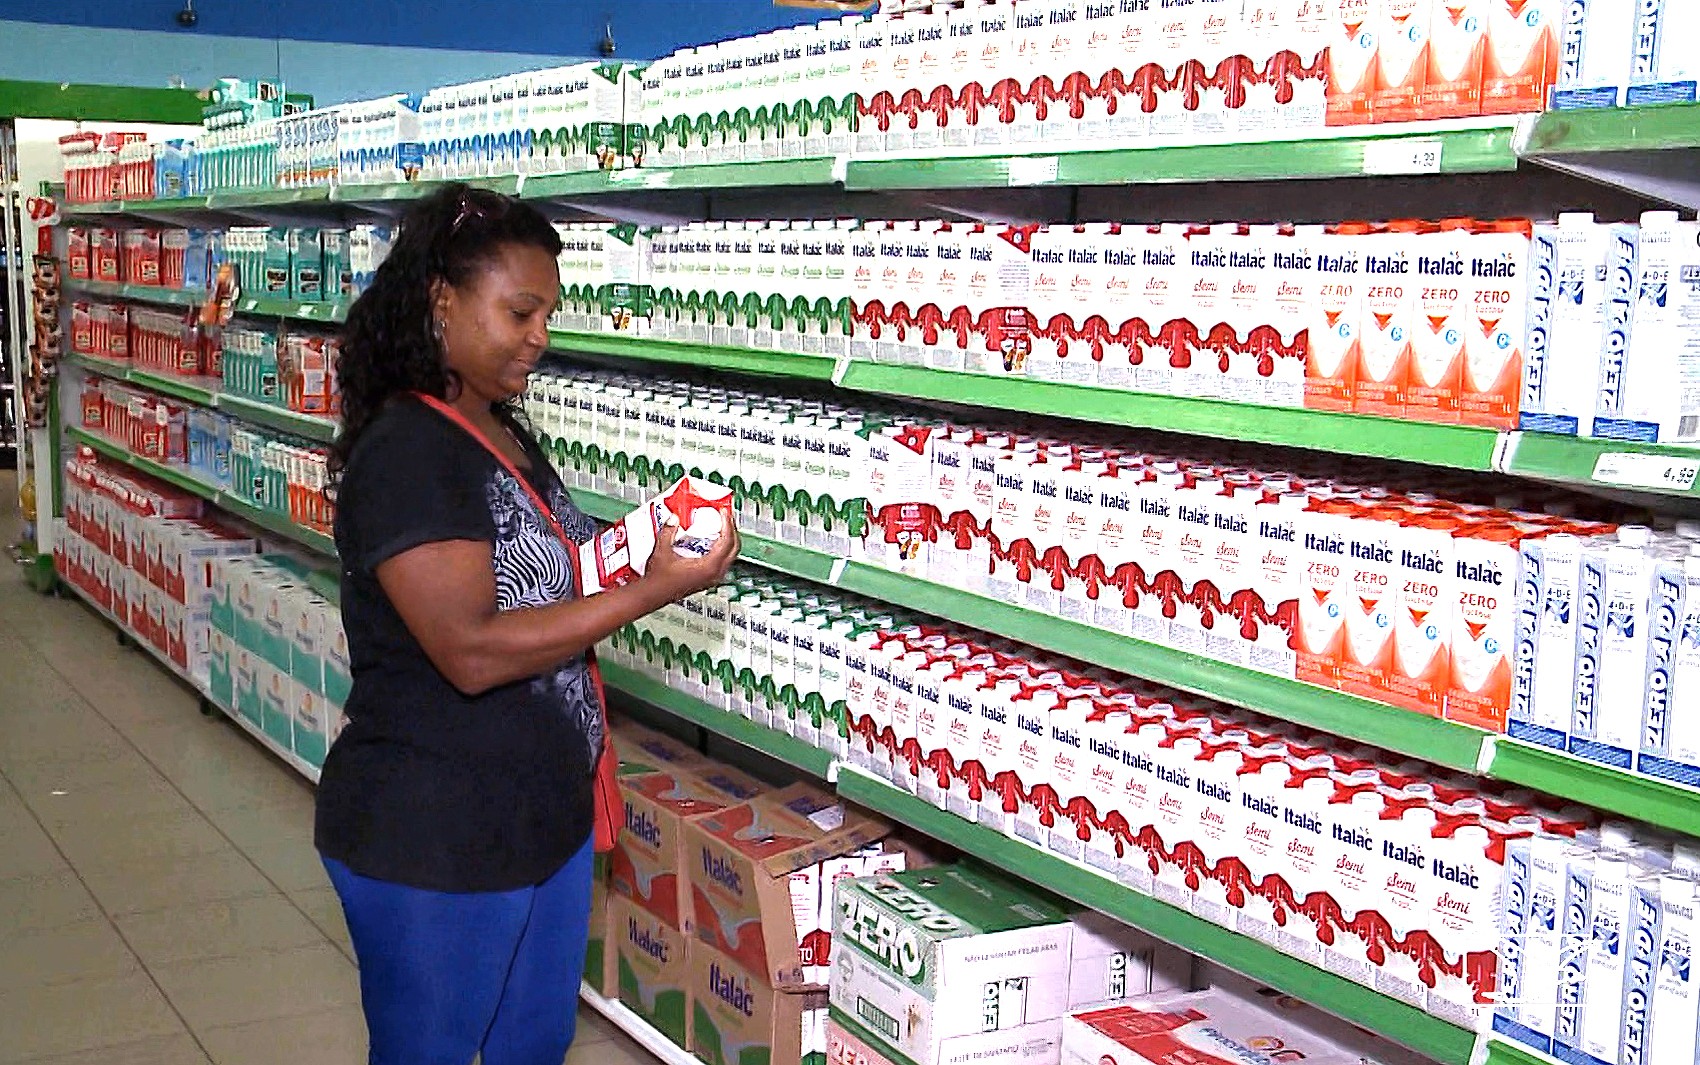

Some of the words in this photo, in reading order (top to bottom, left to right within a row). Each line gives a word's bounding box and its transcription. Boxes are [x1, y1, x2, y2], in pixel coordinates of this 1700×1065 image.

[1049, 9, 1076, 24] Italac
[1086, 4, 1115, 20] Italac
[1032, 248, 1064, 264] Italac
[1068, 248, 1098, 264] Italac
[1104, 249, 1136, 266] Italac
[1143, 249, 1176, 266] Italac
[1192, 250, 1226, 268] Italac
[1229, 250, 1266, 269] Italac
[1274, 252, 1312, 270] Italac
[1317, 254, 1359, 274] Italac
[1366, 254, 1409, 274] Italac
[1418, 256, 1464, 276] Italac
[1472, 257, 1516, 278] Italac
[1321, 284, 1352, 296] ZERO
[1368, 286, 1404, 299] ZERO
[1422, 287, 1458, 302] ZERO
[1474, 290, 1510, 304] ZERO
[996, 474, 1024, 492] Italac
[1033, 480, 1057, 498] Italac
[1066, 486, 1094, 505] Italac
[1100, 493, 1130, 512] Italac
[1140, 498, 1170, 518] Italac
[1178, 506, 1210, 526] Italac
[1214, 512, 1248, 534] Italac
[1260, 522, 1296, 542] Italac
[1304, 534, 1344, 554] Italac
[1350, 540, 1393, 564] Italac
[1308, 562, 1340, 578] ZERO
[1401, 550, 1444, 574] Italac
[1354, 570, 1388, 586] ZERO
[1456, 560, 1502, 586] Italac
[1403, 580, 1438, 598] ZERO
[1460, 592, 1497, 610] ZERO
[948, 694, 972, 715] Italac
[981, 704, 1007, 725] Italac
[1647, 667, 1669, 747] ZERO
[1017, 714, 1044, 736] Italac
[1052, 726, 1080, 748] Italac
[1020, 740, 1038, 756] Semi
[1090, 738, 1120, 760] Italac
[1054, 752, 1075, 768] Semi
[1122, 750, 1154, 774] Italac
[1092, 764, 1114, 781] Semi
[1156, 764, 1190, 789] Italac
[1126, 776, 1147, 795] Semi
[1197, 778, 1231, 803] Italac
[1159, 792, 1182, 810] Semi
[1243, 792, 1279, 818] Italac
[624, 801, 662, 849] Italac
[1200, 806, 1225, 825] Semi
[1284, 807, 1322, 834] Italac
[1246, 822, 1272, 841] Semi
[1333, 823, 1373, 851] Italac
[1288, 838, 1315, 857] Semi
[1383, 840, 1425, 869] Italac
[702, 846, 744, 897] Italac
[1336, 854, 1364, 875] Semi
[1433, 858, 1479, 890] Italac
[1386, 872, 1416, 894] Semi
[1438, 892, 1471, 915] Semi
[628, 916, 668, 964] Italac
[839, 890, 926, 983] ZERO
[710, 962, 753, 1018] Italac
